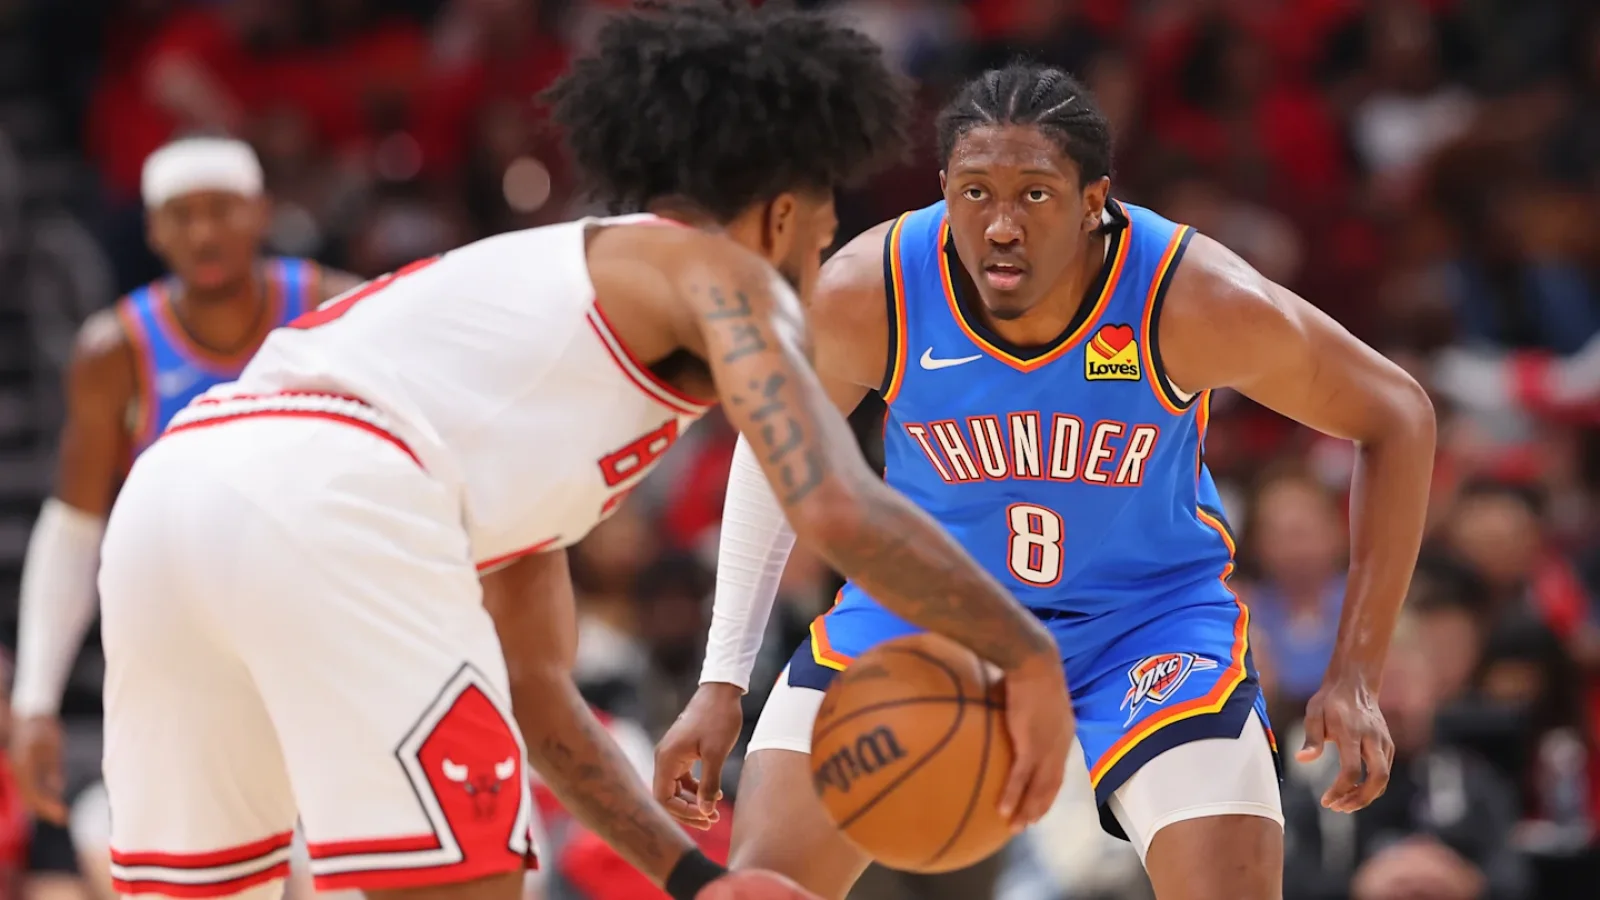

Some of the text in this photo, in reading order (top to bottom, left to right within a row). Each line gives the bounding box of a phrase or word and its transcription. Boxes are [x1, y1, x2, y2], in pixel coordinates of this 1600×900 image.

[904, 410, 1160, 487] THUNDER
[1005, 502, 1065, 588] 8
[1132, 656, 1180, 707] OKC
